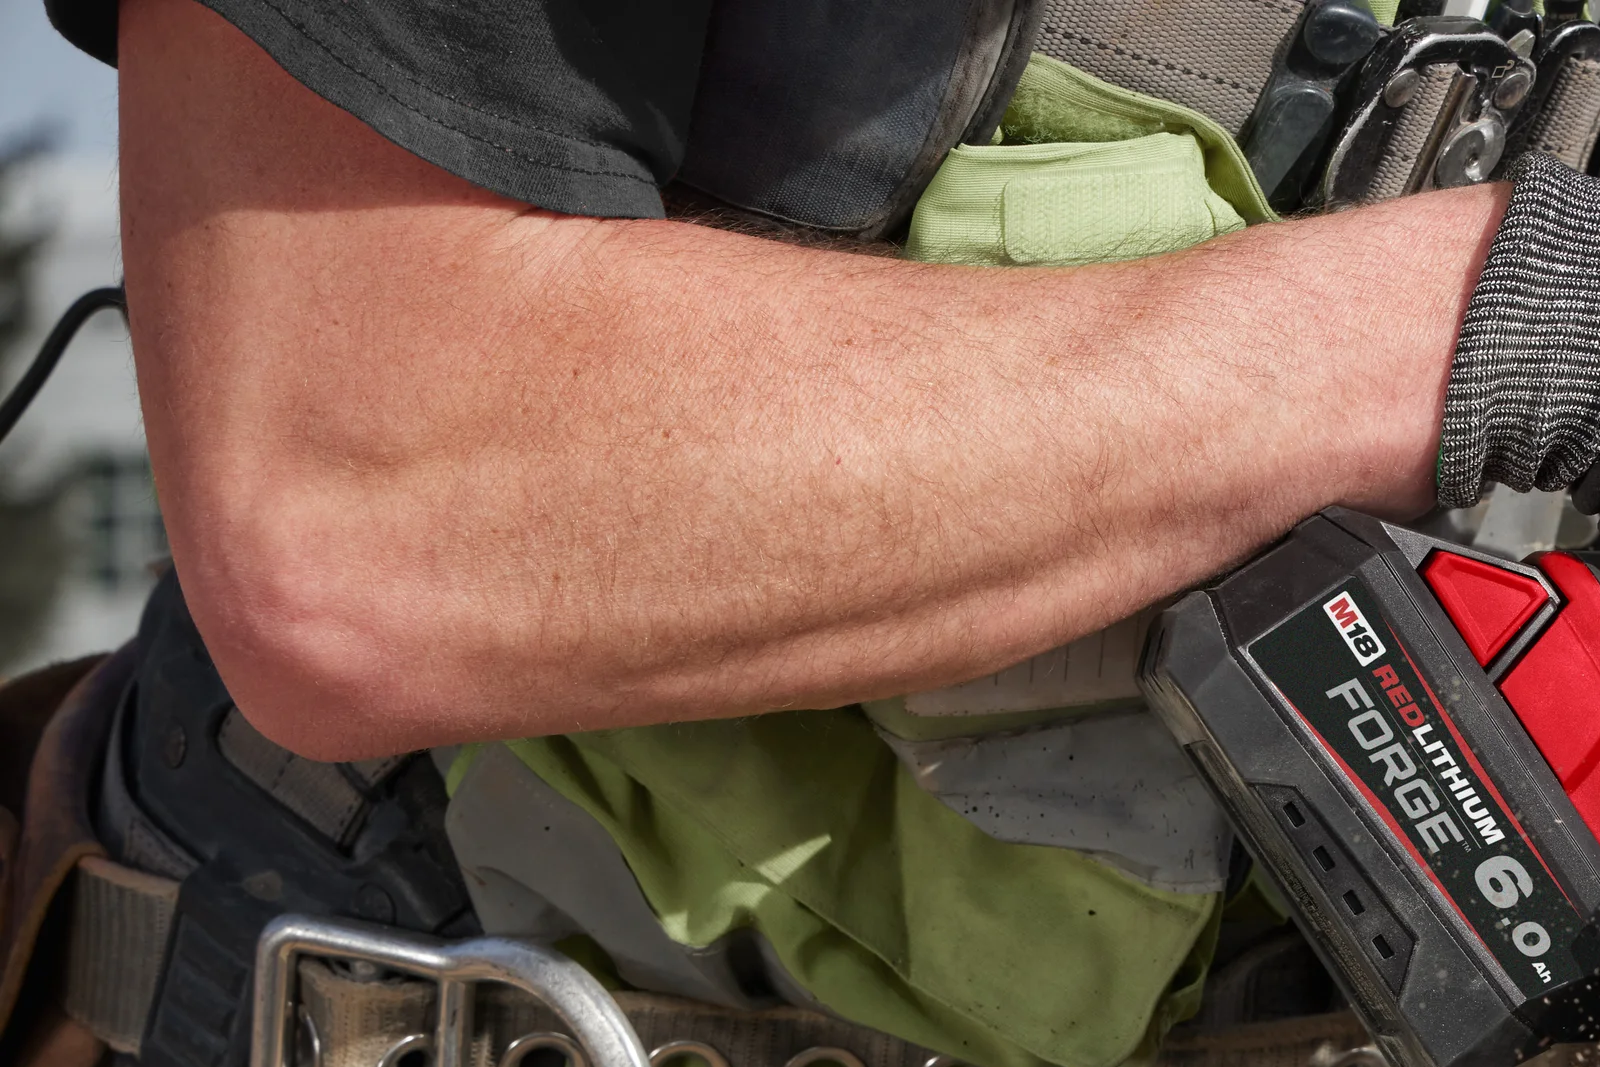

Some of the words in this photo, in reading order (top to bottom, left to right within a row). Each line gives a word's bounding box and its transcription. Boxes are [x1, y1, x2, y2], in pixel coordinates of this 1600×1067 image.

[1329, 597, 1380, 661] M18
[1373, 664, 1506, 845] REDLITHIUM
[1474, 854, 1552, 957] 6.0
[1532, 960, 1552, 984] Ah
